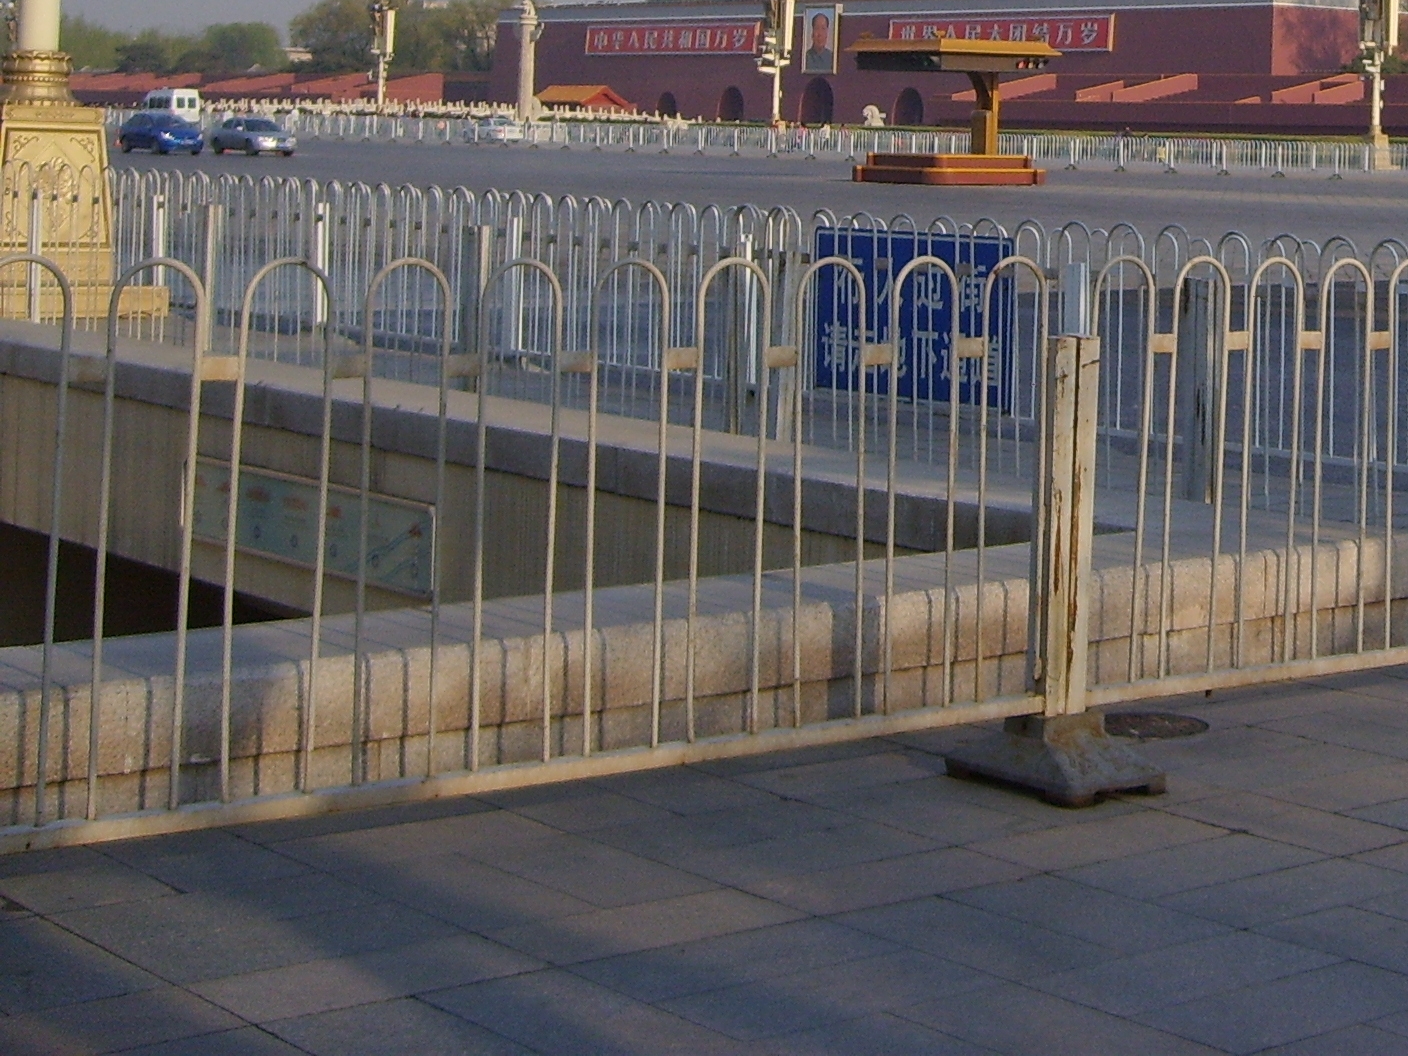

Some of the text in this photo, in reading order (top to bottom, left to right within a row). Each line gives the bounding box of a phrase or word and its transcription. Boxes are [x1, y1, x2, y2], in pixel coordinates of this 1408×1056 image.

[593, 28, 748, 50] 中华人民共和国万岁
